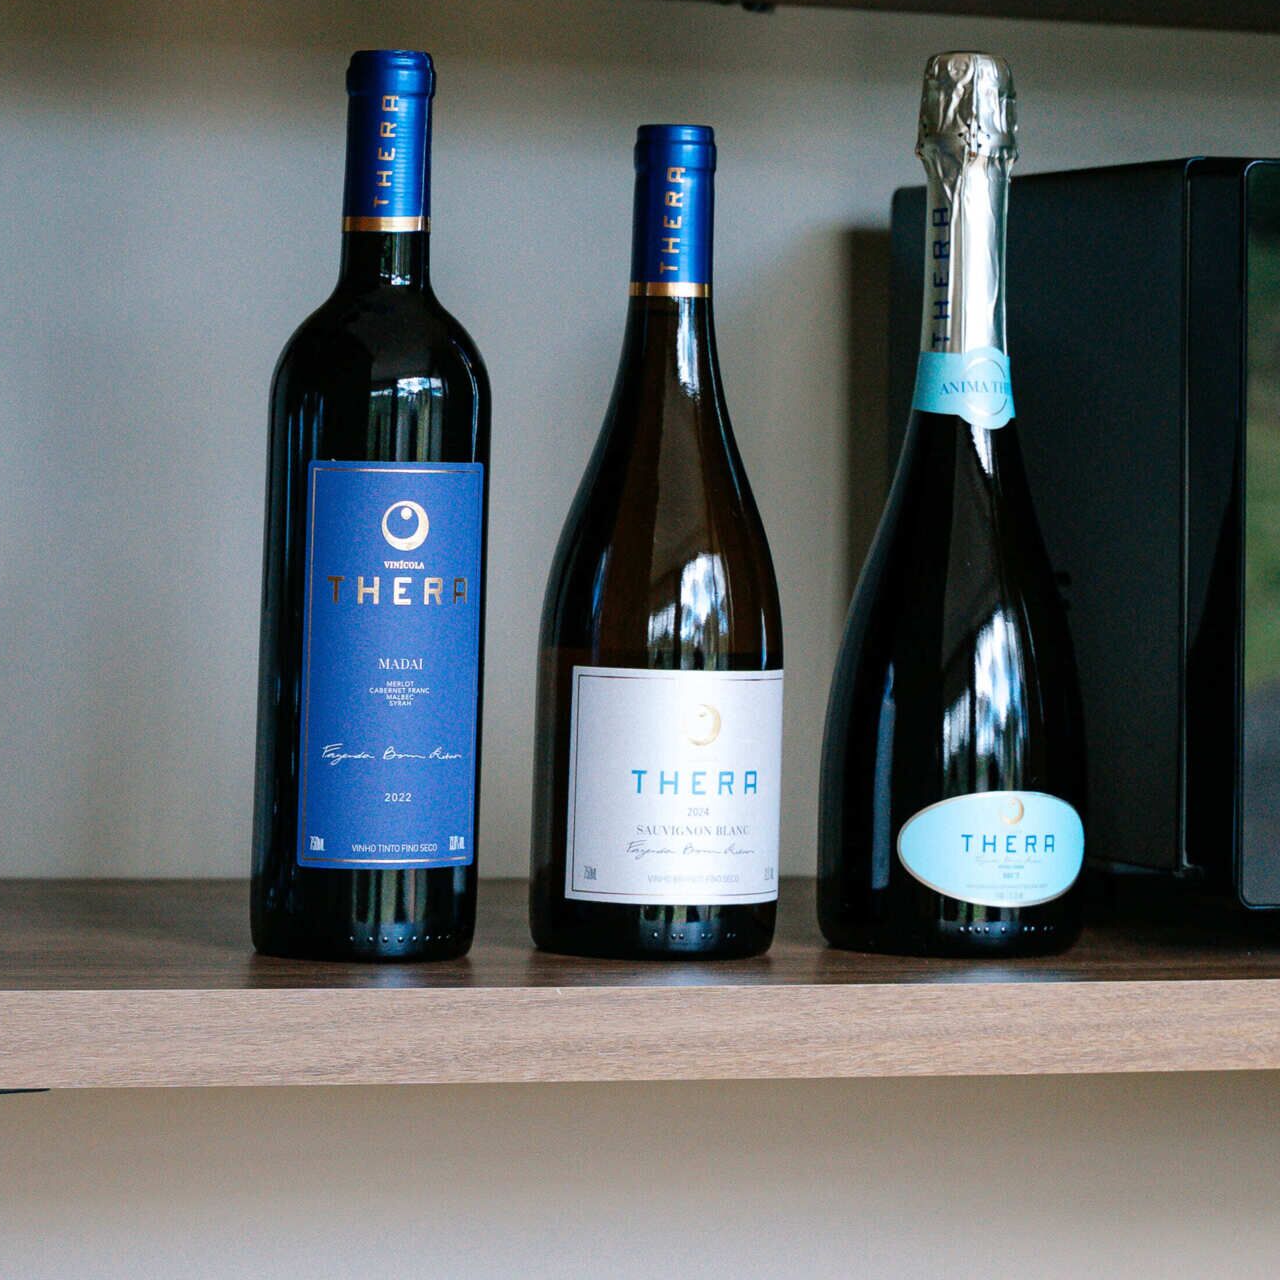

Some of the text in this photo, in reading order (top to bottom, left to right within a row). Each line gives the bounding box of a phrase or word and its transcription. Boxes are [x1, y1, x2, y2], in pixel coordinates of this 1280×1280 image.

[373, 94, 400, 209] THERA
[659, 166, 687, 274] THERA
[932, 206, 951, 349] THERA
[939, 380, 990, 396] ANIMA
[384, 560, 425, 570] VINÍCOLA
[327, 575, 468, 606] THERA
[377, 657, 424, 671] MADAI
[386, 680, 415, 688] MERLOT
[385, 693, 415, 701] MALBEC
[631, 769, 758, 796] THERA
[383, 792, 413, 803] 2022
[635, 825, 752, 836] SAUVIGNON BLANC
[351, 843, 377, 853] VINHO
[378, 843, 400, 853] TINTO
[401, 843, 419, 853] FINO
[420, 842, 438, 853] SECO
[960, 833, 1056, 854] THERA
